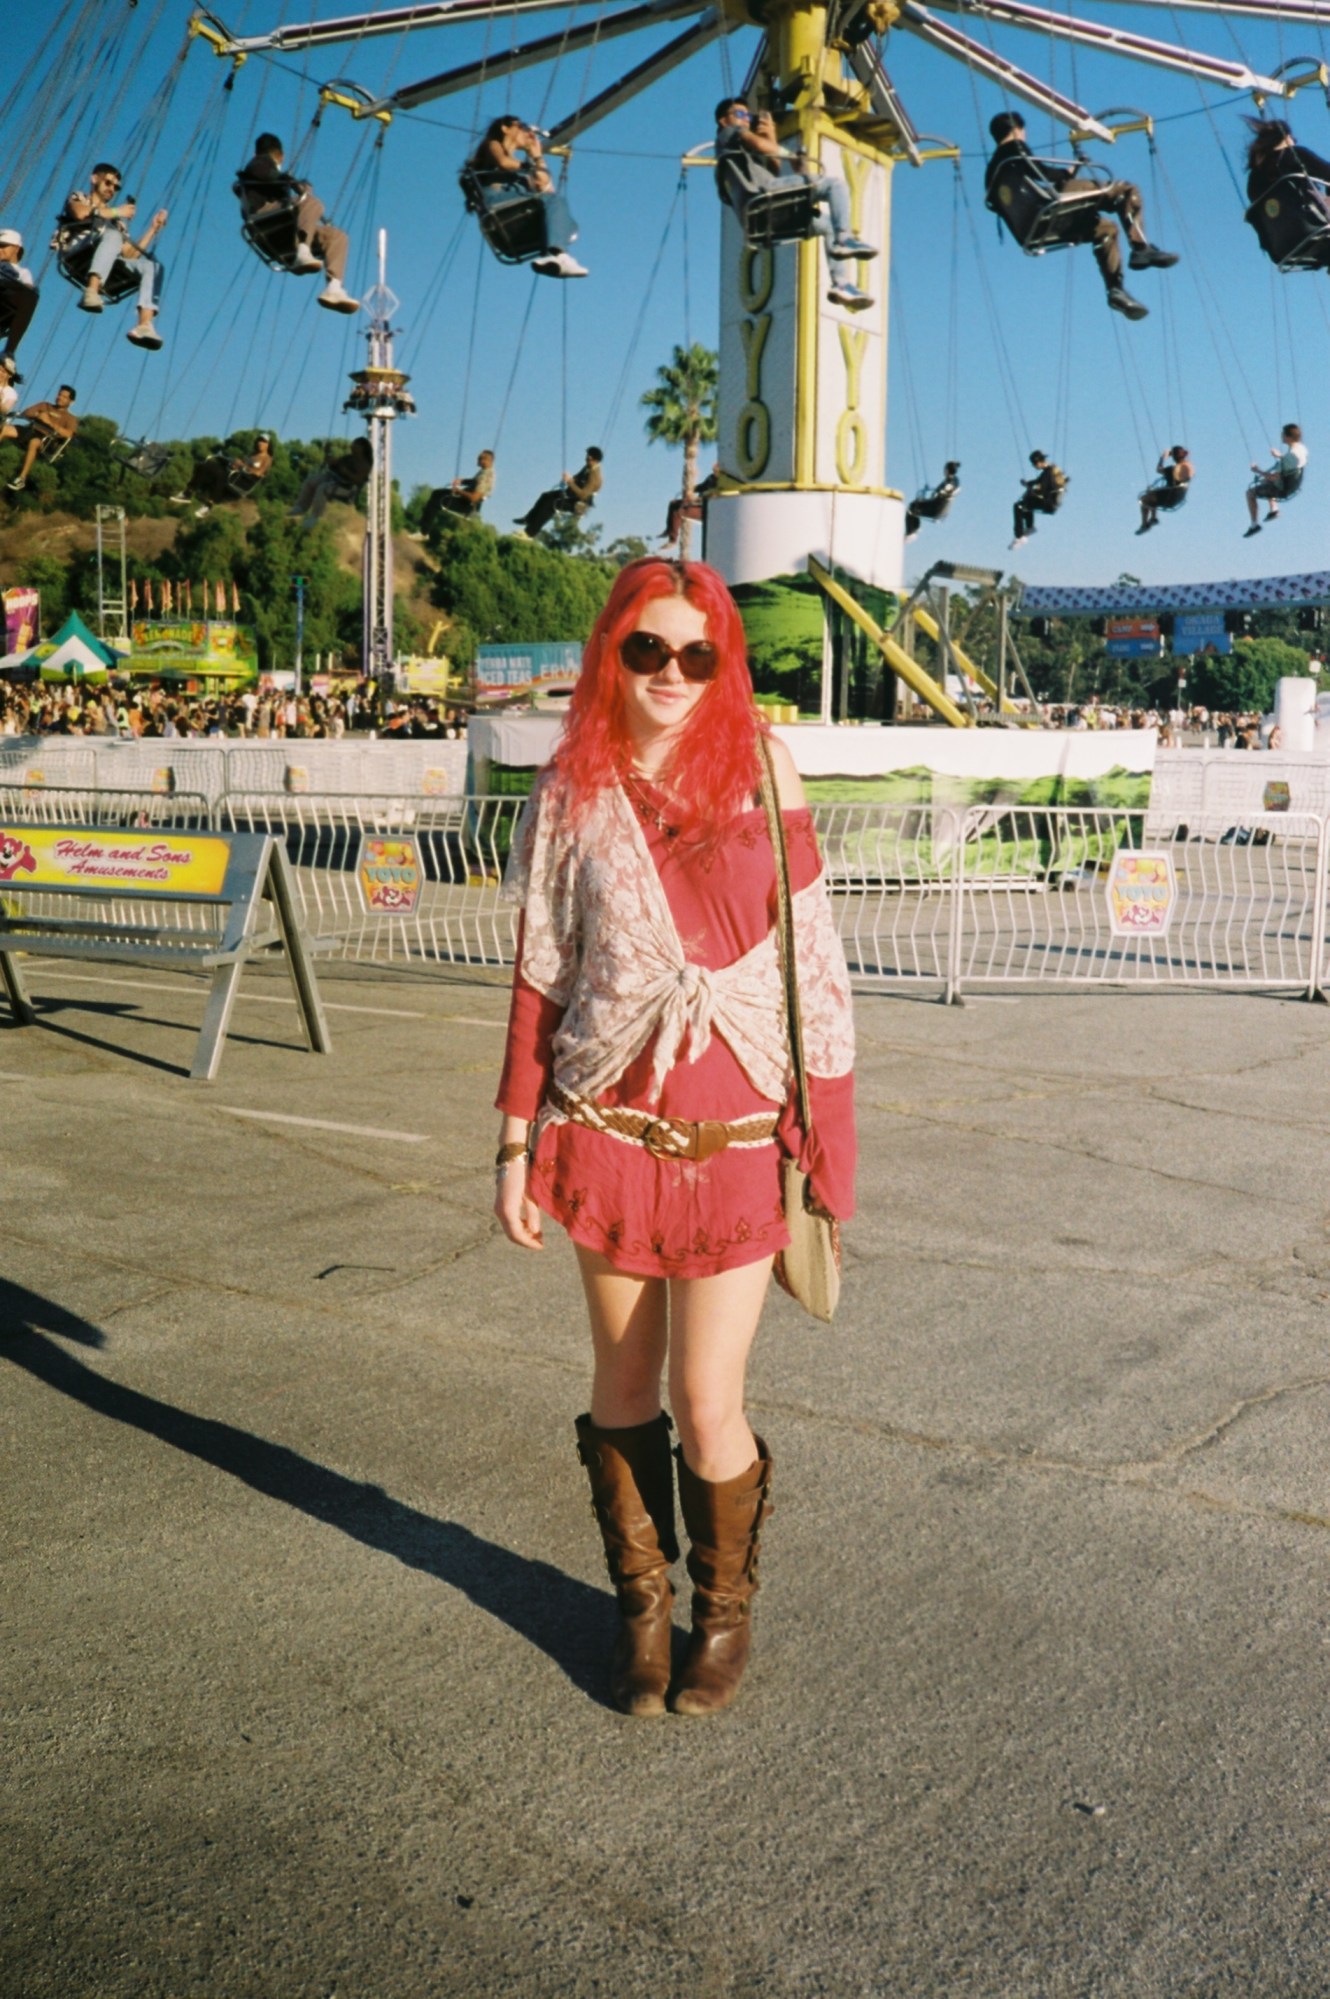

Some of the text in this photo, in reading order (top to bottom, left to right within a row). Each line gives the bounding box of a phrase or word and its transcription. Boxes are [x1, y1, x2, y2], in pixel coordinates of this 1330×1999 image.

[507, 669, 532, 685] TEAS
[56, 839, 191, 864] Helm and Sons
[67, 859, 169, 880] Amusements
[364, 866, 417, 885] YOYO
[1115, 884, 1167, 902] YOYO
